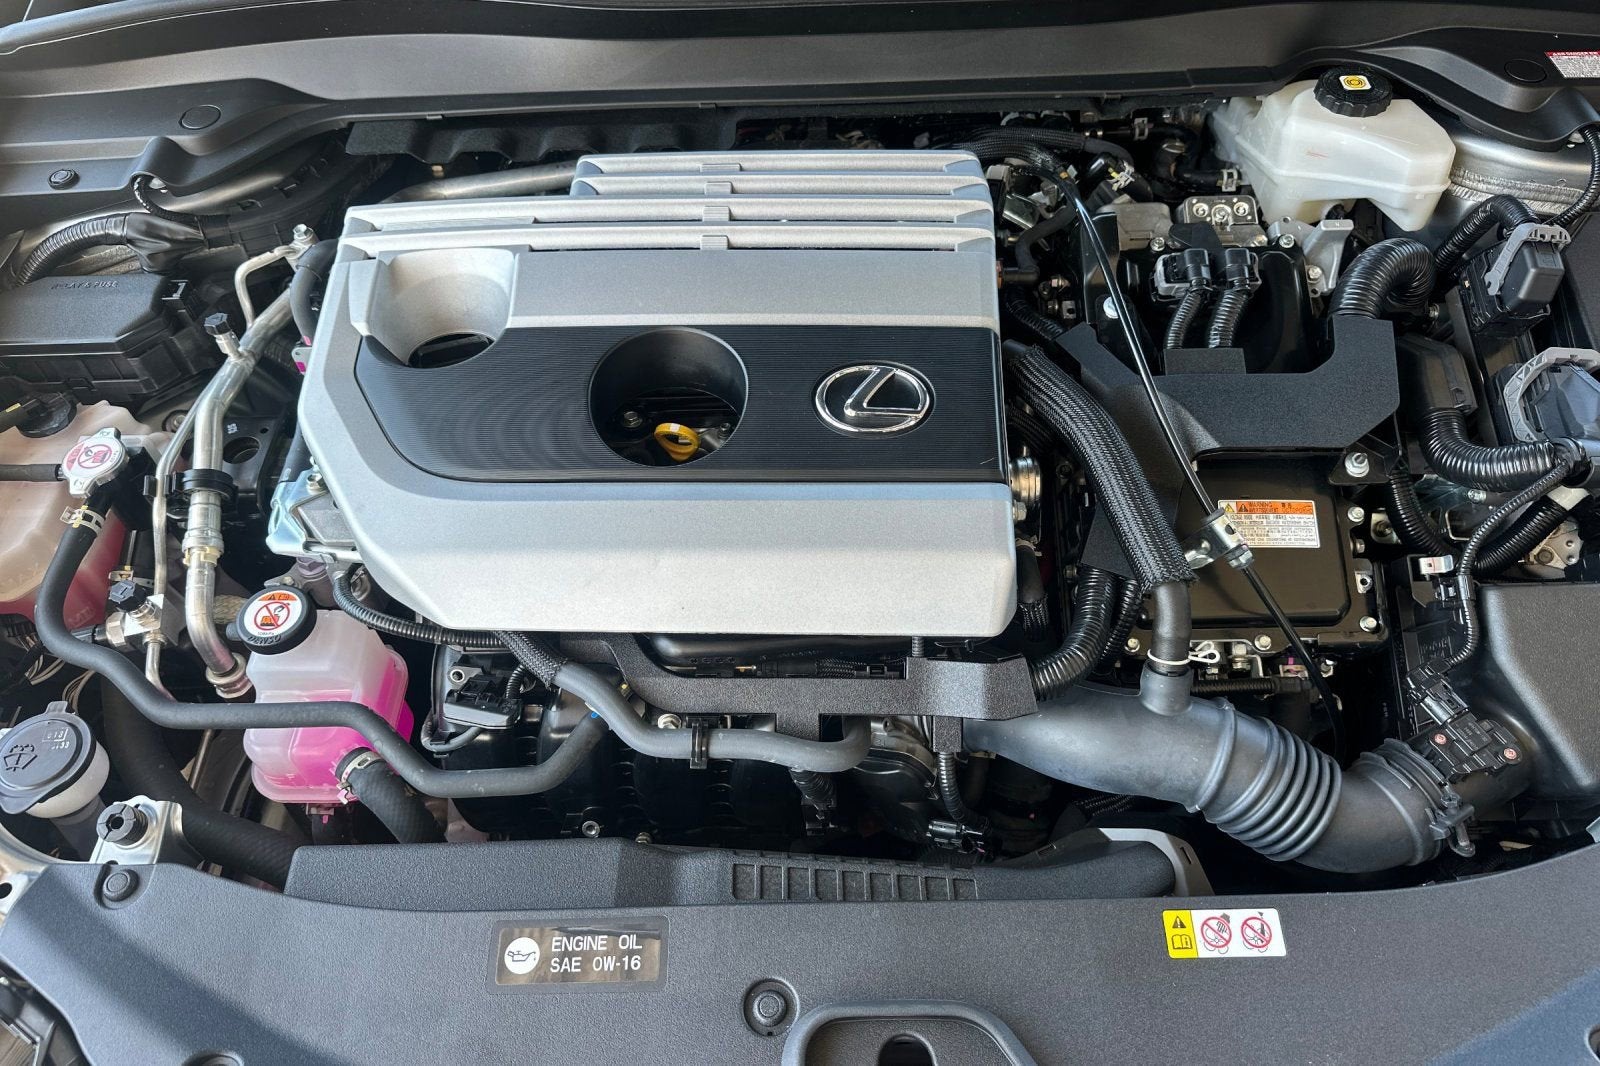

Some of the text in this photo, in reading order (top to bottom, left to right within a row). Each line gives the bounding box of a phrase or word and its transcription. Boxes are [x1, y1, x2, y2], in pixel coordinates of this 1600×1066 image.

[551, 934, 643, 952] ENGINE OIL
[549, 955, 642, 973] SAE 0W-16
